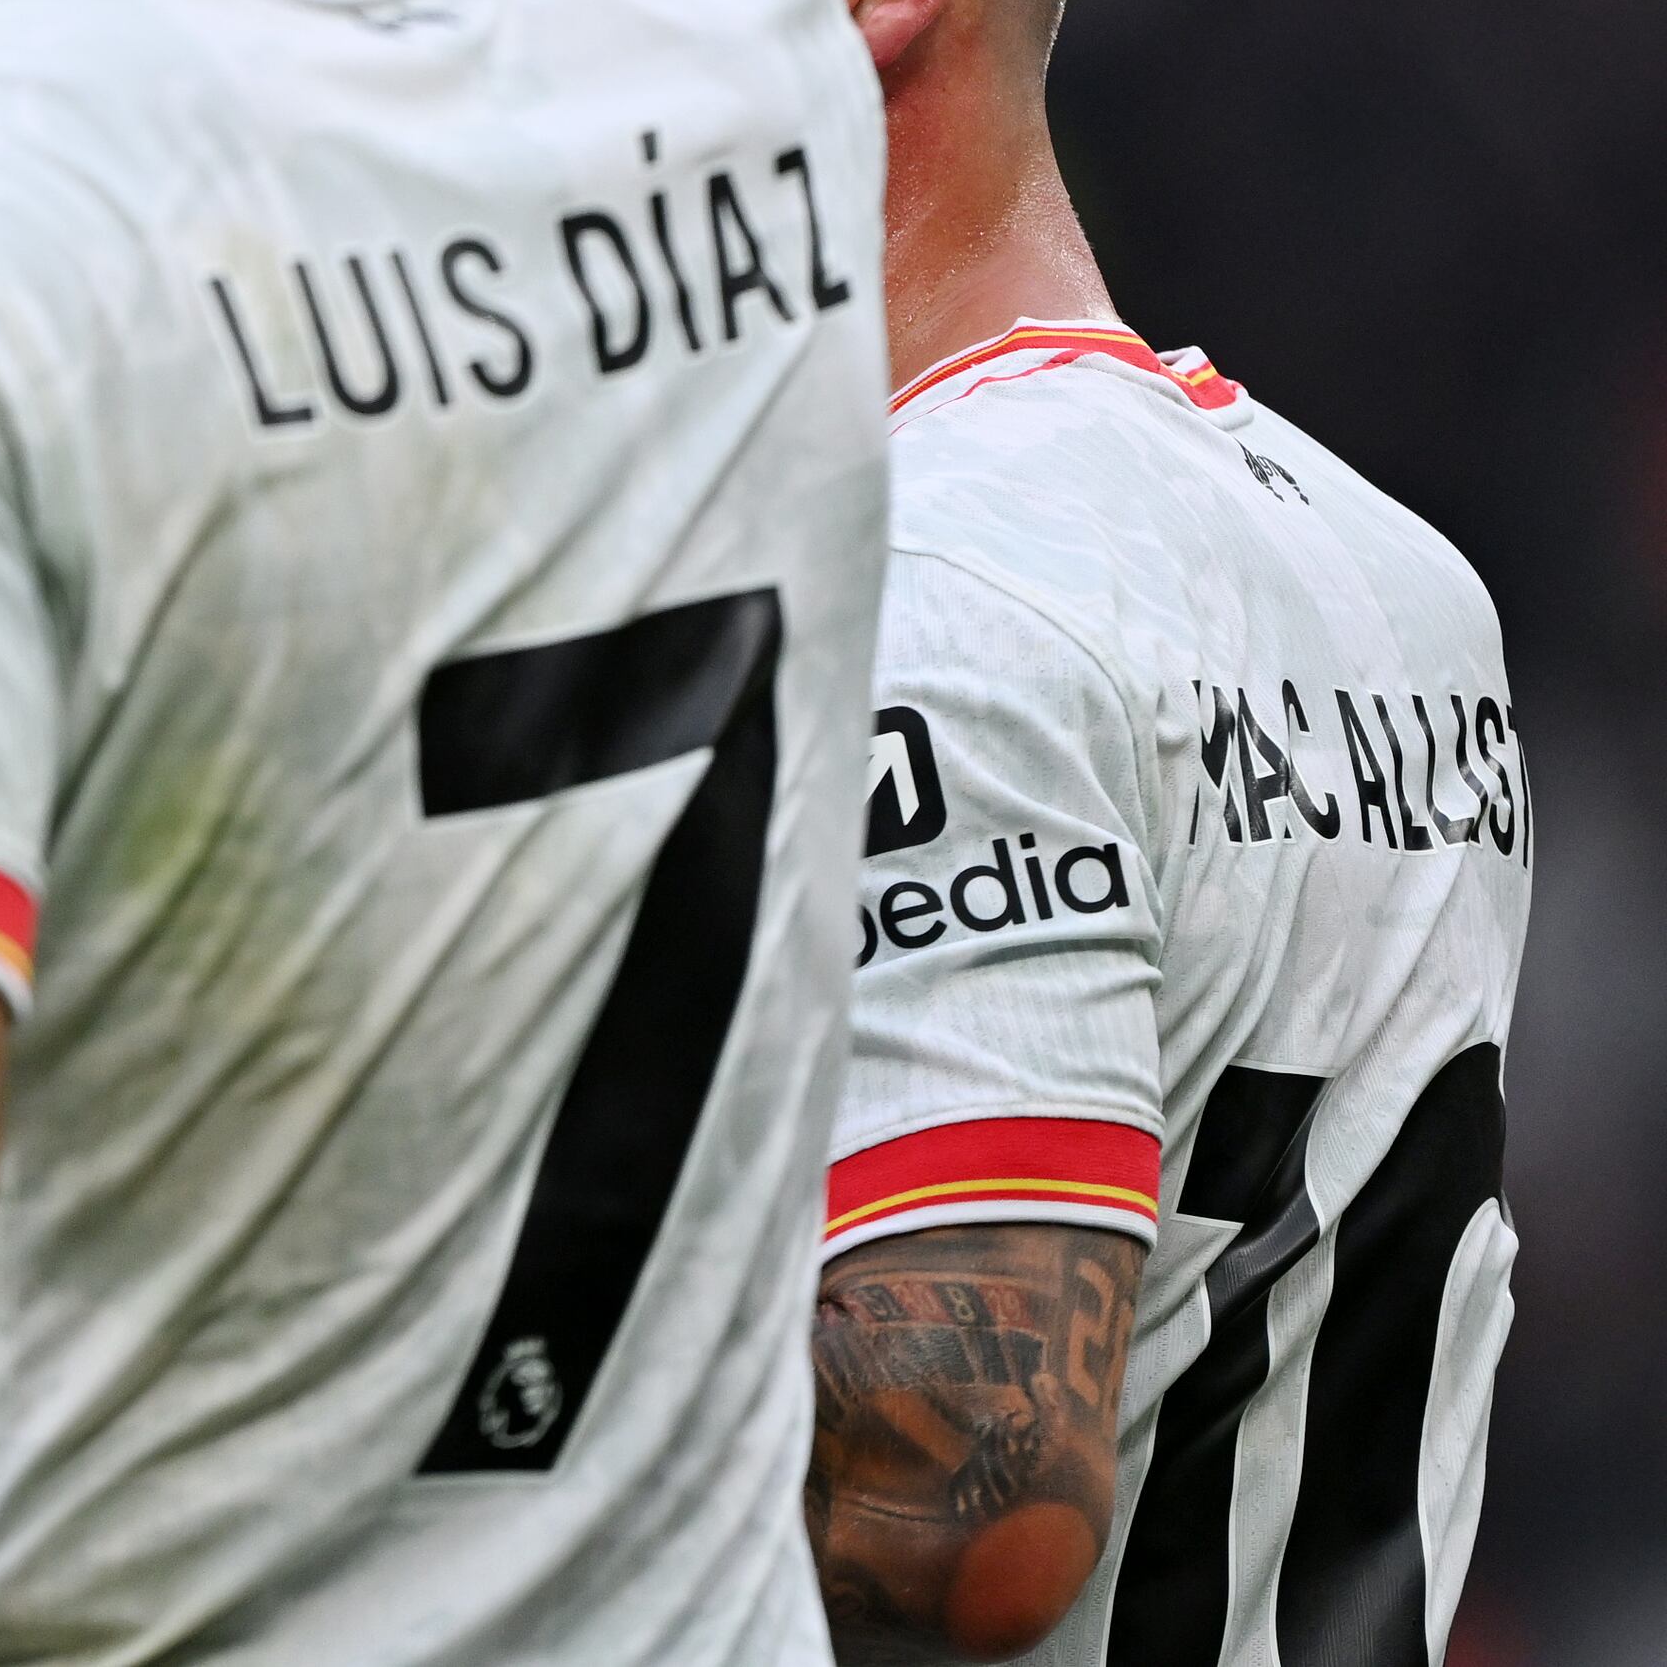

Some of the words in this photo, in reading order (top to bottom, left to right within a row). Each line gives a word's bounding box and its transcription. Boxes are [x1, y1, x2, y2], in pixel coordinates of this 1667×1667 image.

[209, 239, 534, 426] LUIS
[558, 131, 851, 375] DÍAZ
[1190, 679, 1342, 843] MAC
[414, 585, 784, 1476] 7
[1105, 1040, 1505, 1667] 10
